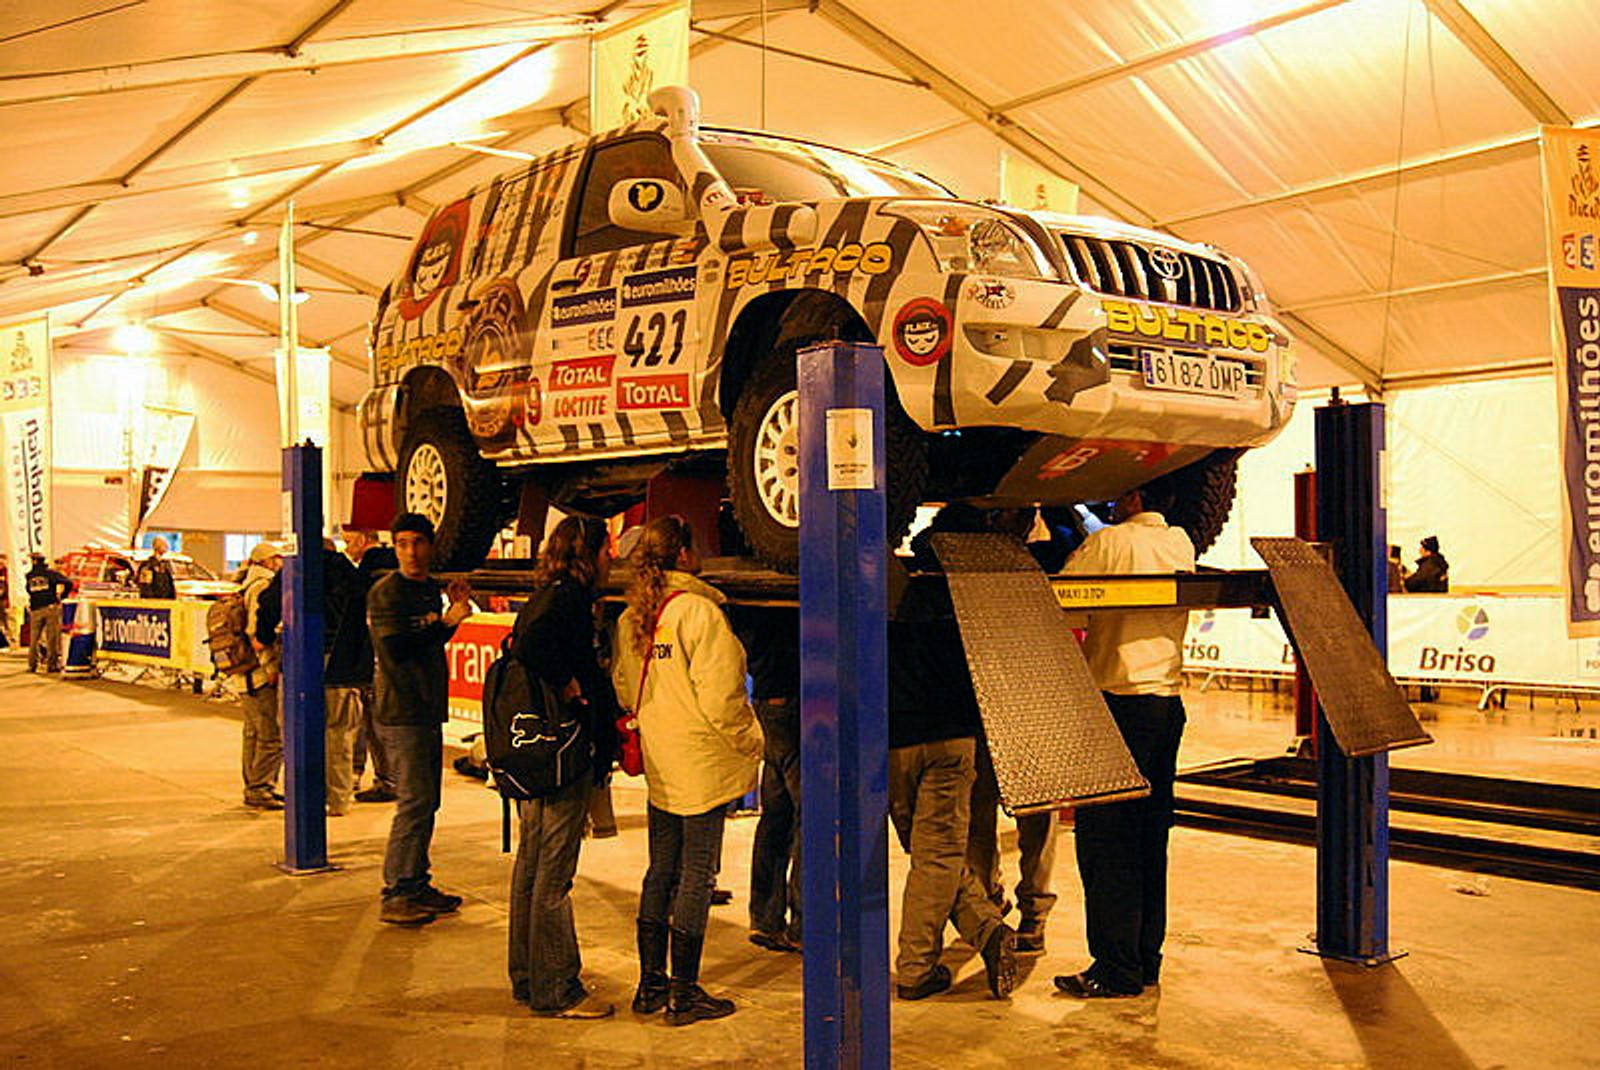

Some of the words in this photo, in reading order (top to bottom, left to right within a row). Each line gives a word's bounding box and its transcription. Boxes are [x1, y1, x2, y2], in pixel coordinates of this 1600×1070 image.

[727, 242, 893, 290] BULTACO
[623, 308, 687, 367] 421
[1102, 299, 1270, 352] BULTACO
[556, 366, 607, 386] TOTAL
[1156, 357, 1204, 388] 6182
[554, 395, 608, 418] LOCTITE
[621, 381, 683, 404] TOTAL
[1419, 646, 1496, 673] Brisa
